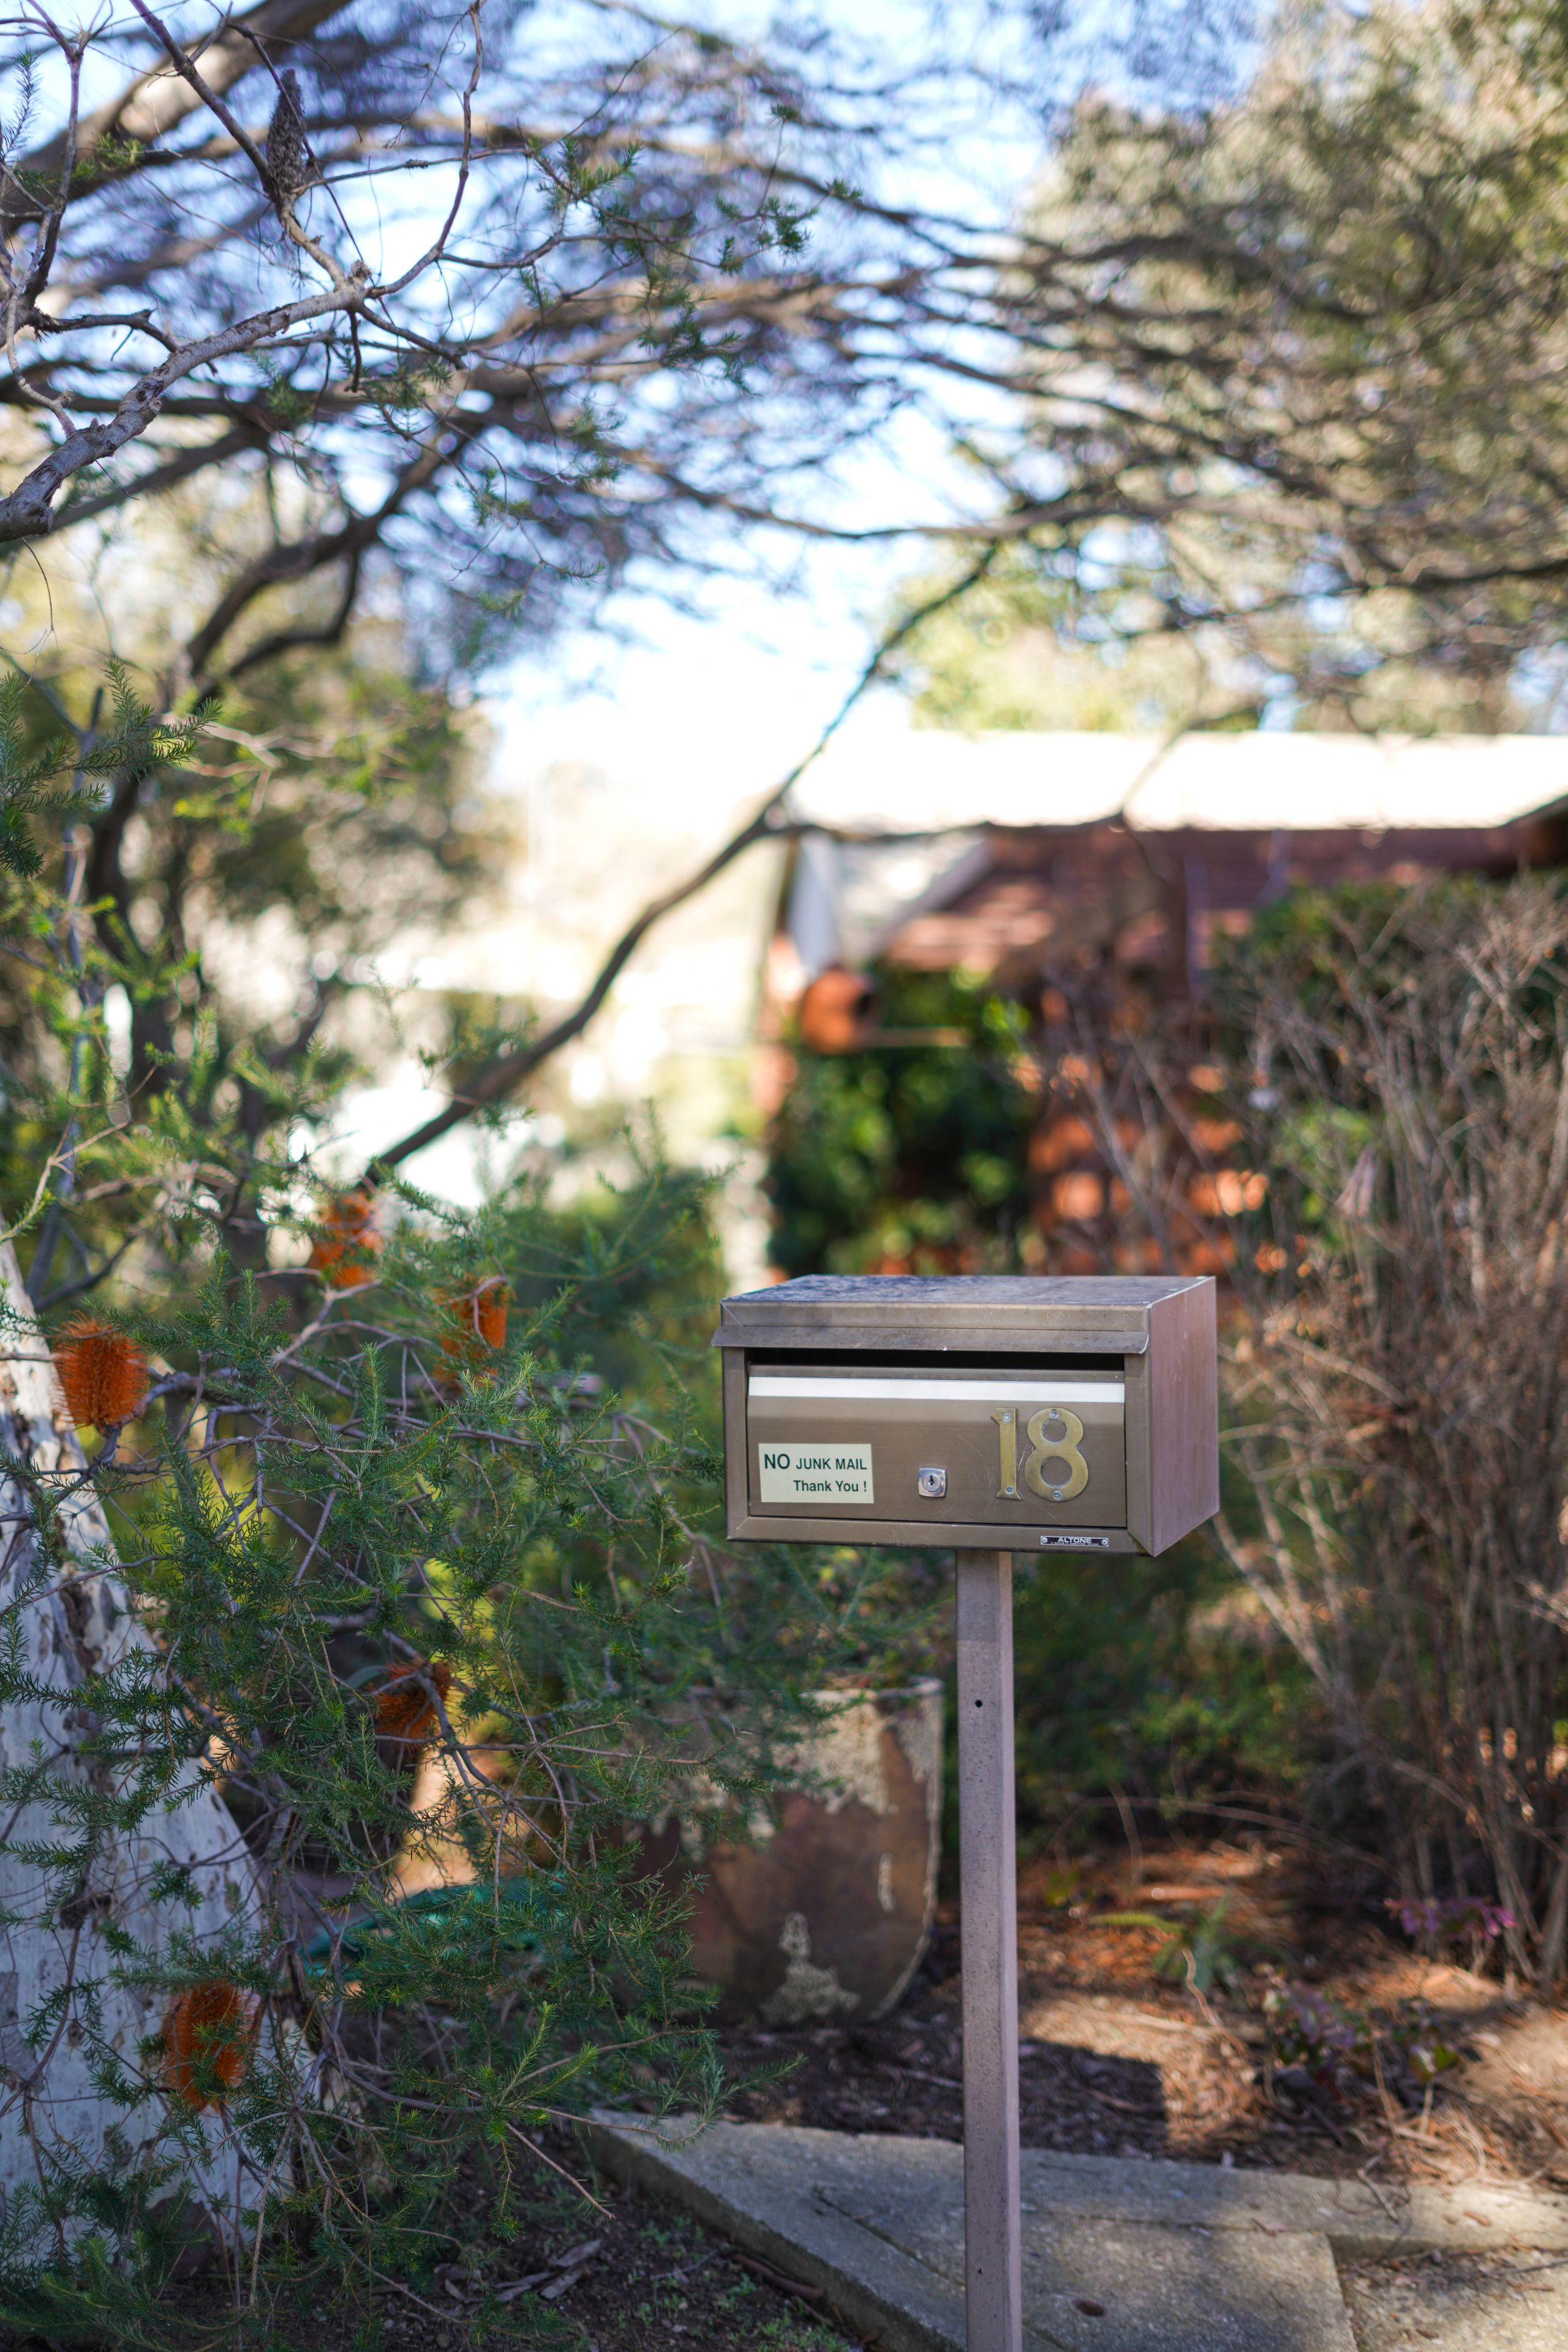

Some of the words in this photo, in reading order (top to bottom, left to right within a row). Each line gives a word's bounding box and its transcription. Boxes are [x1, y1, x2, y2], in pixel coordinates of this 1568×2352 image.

[764, 1453, 790, 1469] NO
[796, 1458, 831, 1469] JUNK
[835, 1458, 867, 1470] MAIL
[991, 1408, 1088, 1501] 18
[793, 1480, 832, 1491] Thank
[835, 1480, 859, 1491] You
